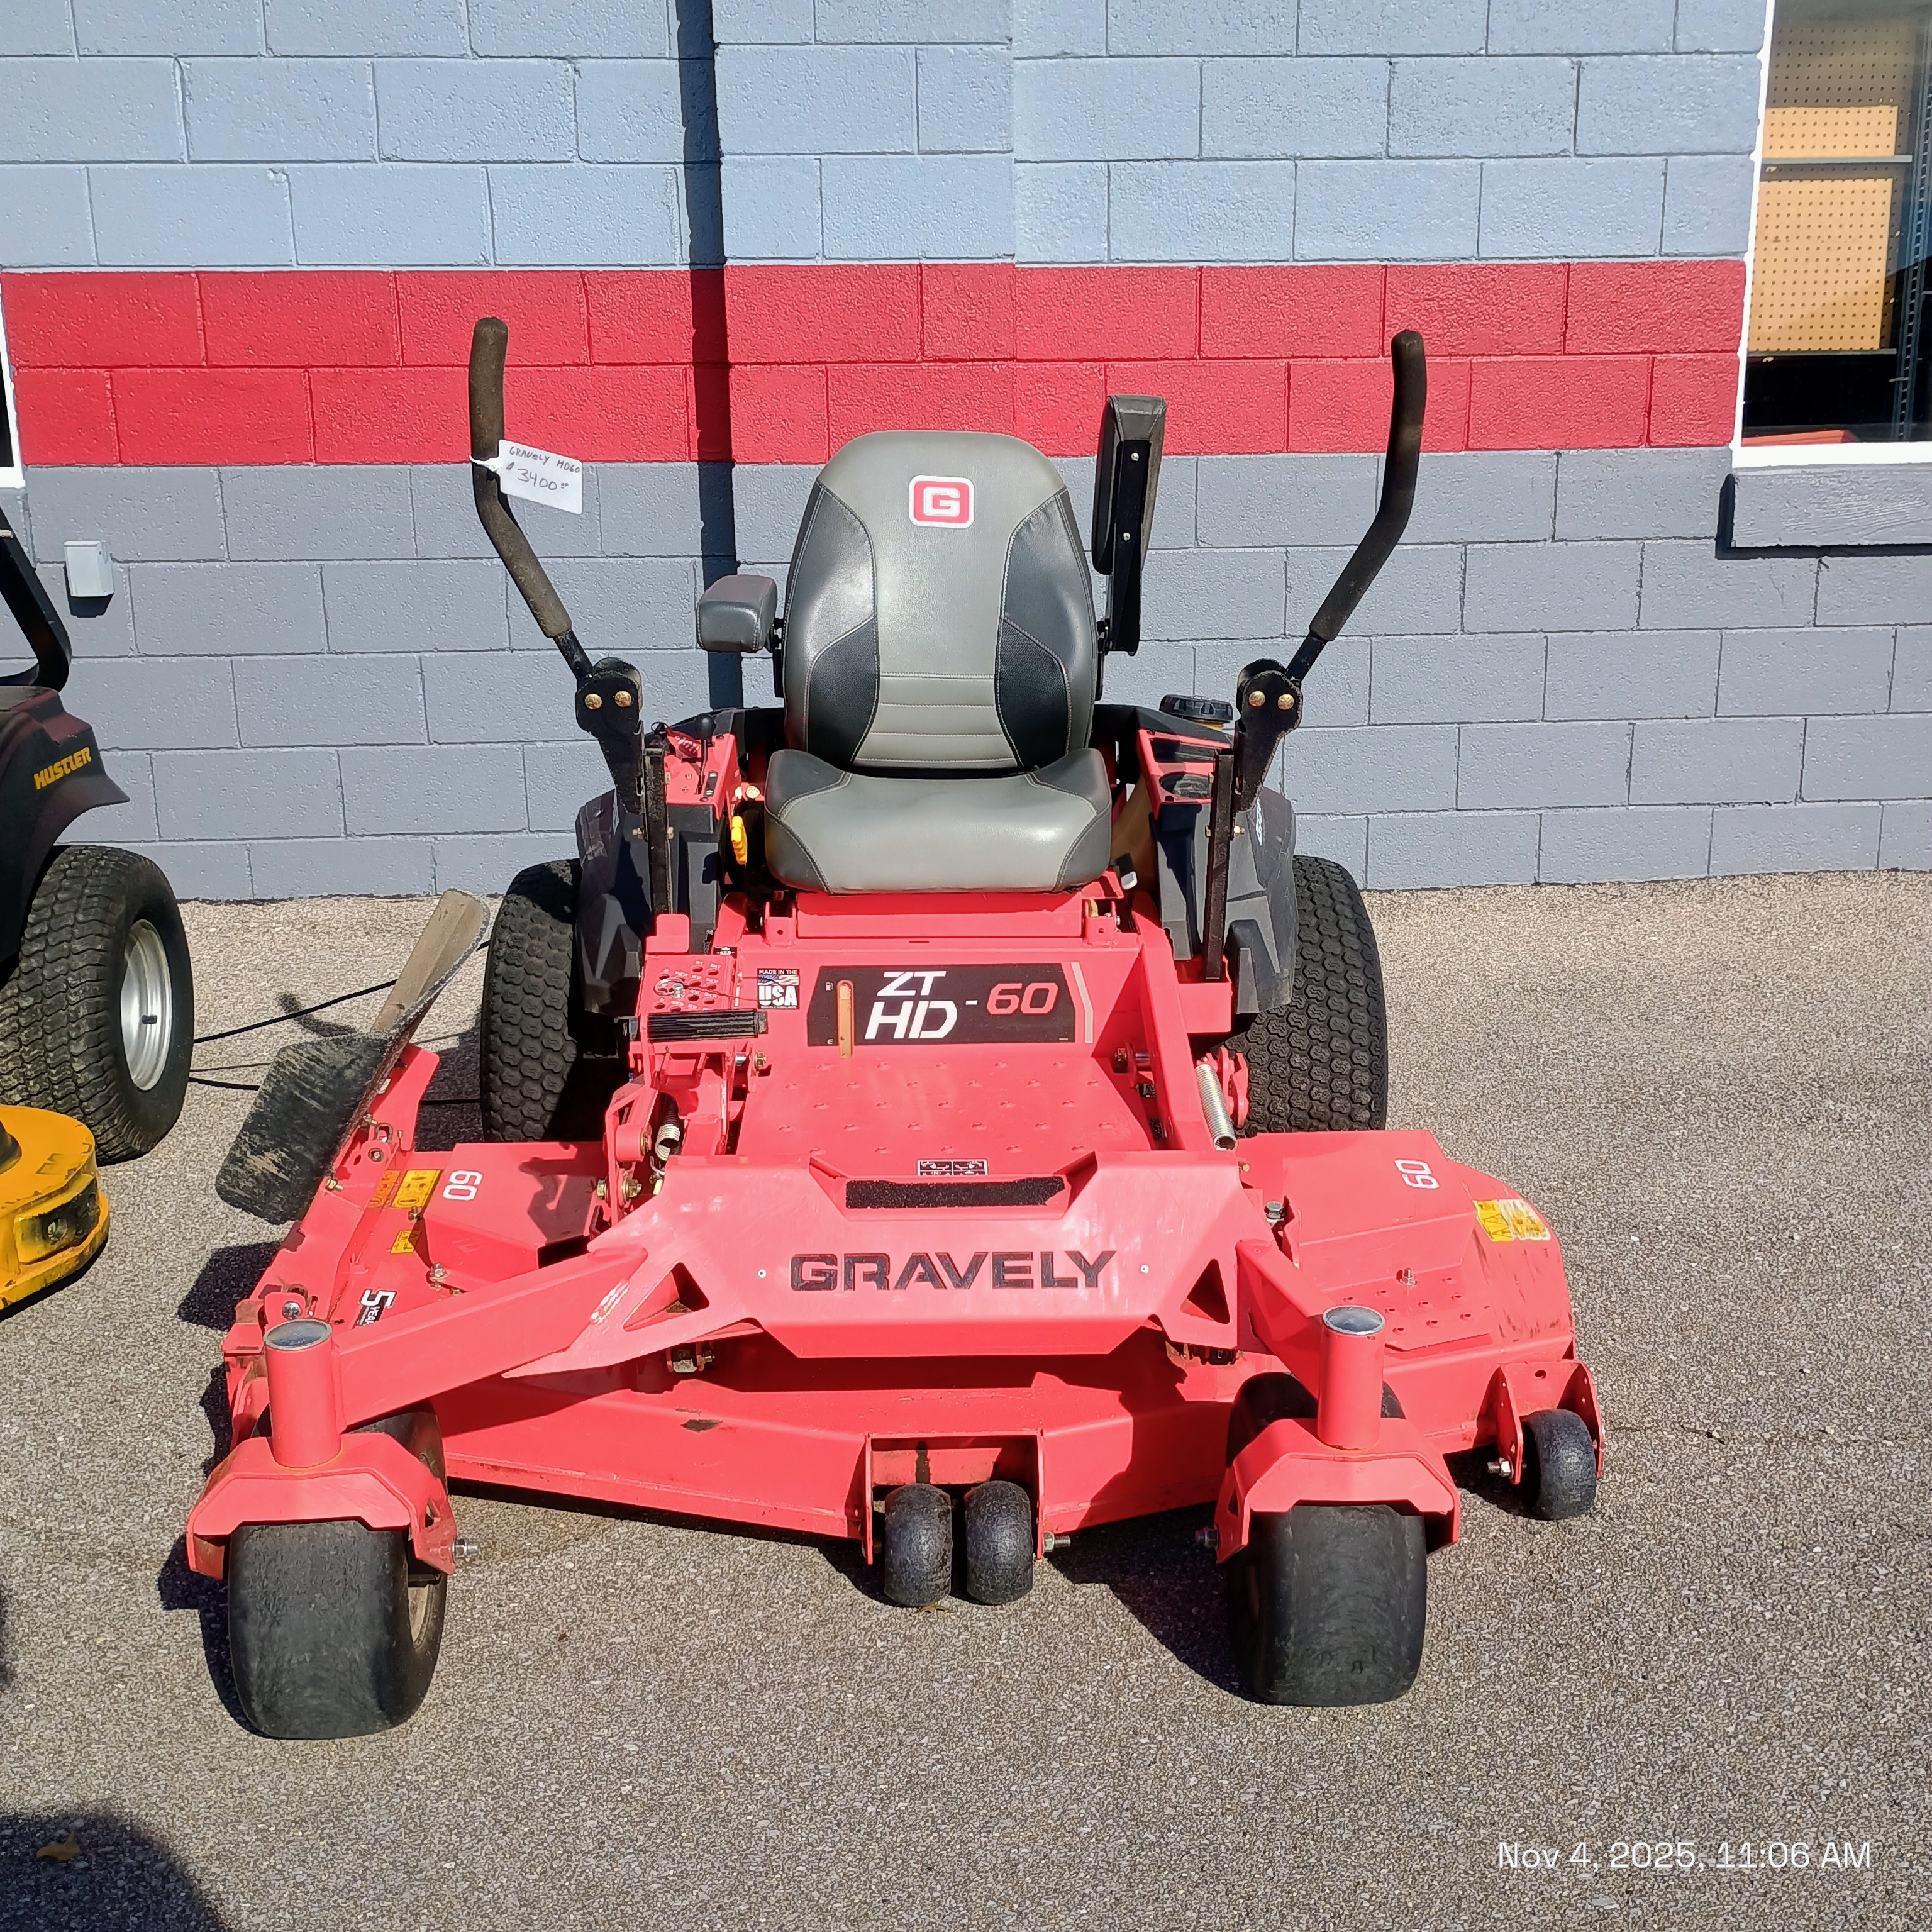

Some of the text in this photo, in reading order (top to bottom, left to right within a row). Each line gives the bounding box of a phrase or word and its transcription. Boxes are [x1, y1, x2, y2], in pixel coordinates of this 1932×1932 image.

[923, 487, 960, 517] G
[33, 747, 92, 790] HUSTLER
[758, 985, 797, 1006] USA
[877, 970, 947, 996] ZT
[442, 1170, 483, 1201] 60
[1394, 1159, 1440, 1189] 60
[790, 1250, 1117, 1292] GRAVELY
[360, 1289, 396, 1307] 5
